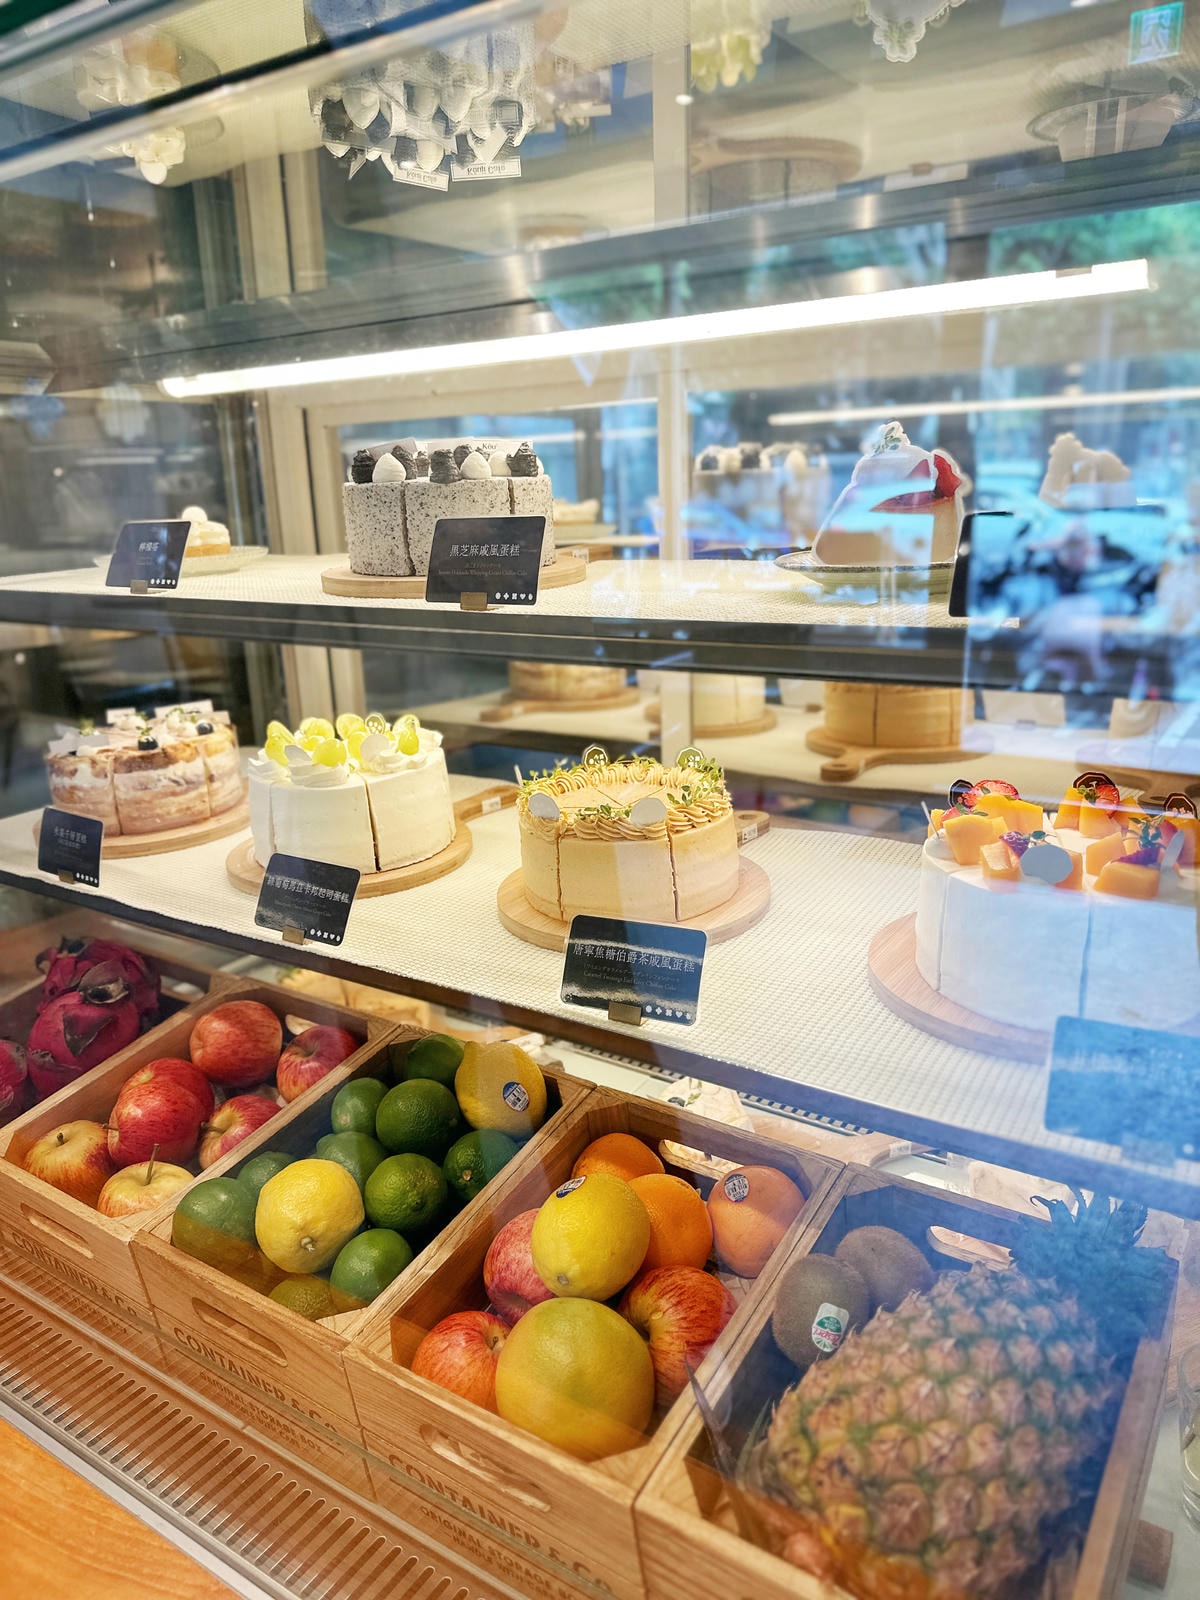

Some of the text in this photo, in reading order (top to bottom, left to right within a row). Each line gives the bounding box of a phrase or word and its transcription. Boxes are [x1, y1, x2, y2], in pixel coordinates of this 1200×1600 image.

[449, 543, 521, 558] 黑芝麻戚風蛋糕
